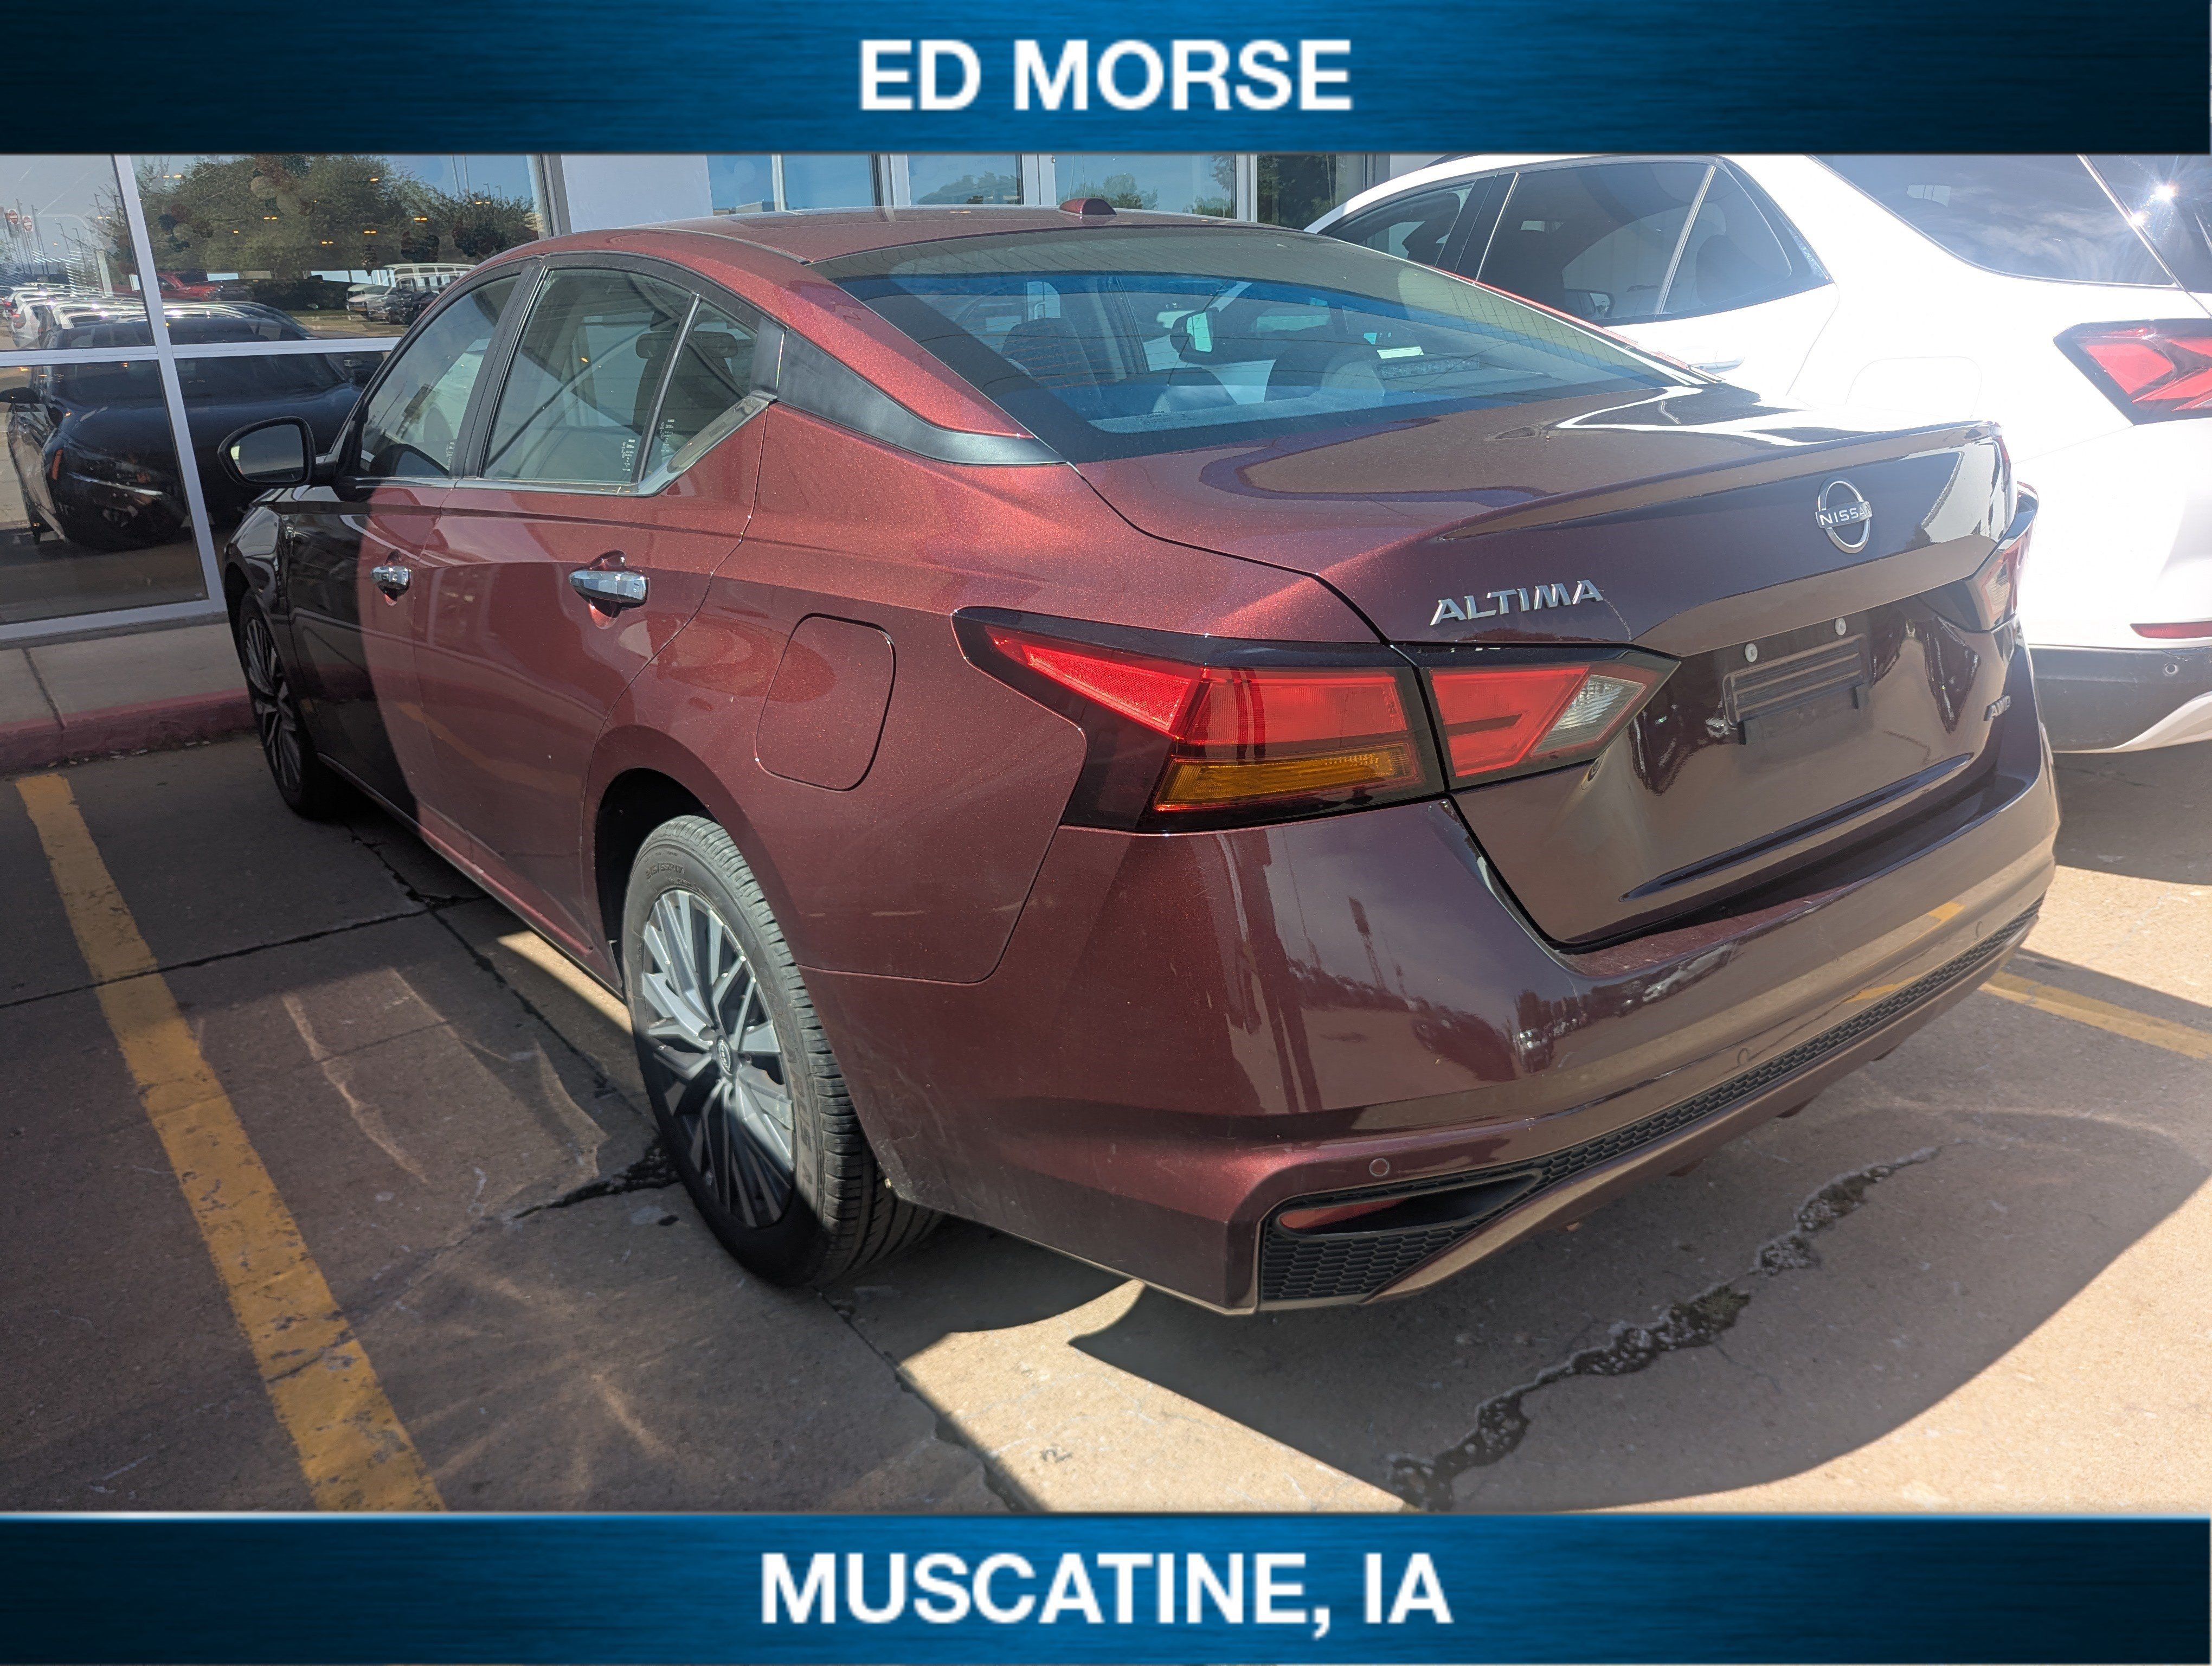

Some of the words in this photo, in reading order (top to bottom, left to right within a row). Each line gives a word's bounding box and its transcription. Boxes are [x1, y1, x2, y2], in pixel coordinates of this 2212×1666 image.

[1819, 502, 1872, 526] NISSAN
[1429, 579, 1604, 626] ALTIMA
[1984, 695, 2010, 720] AWD
